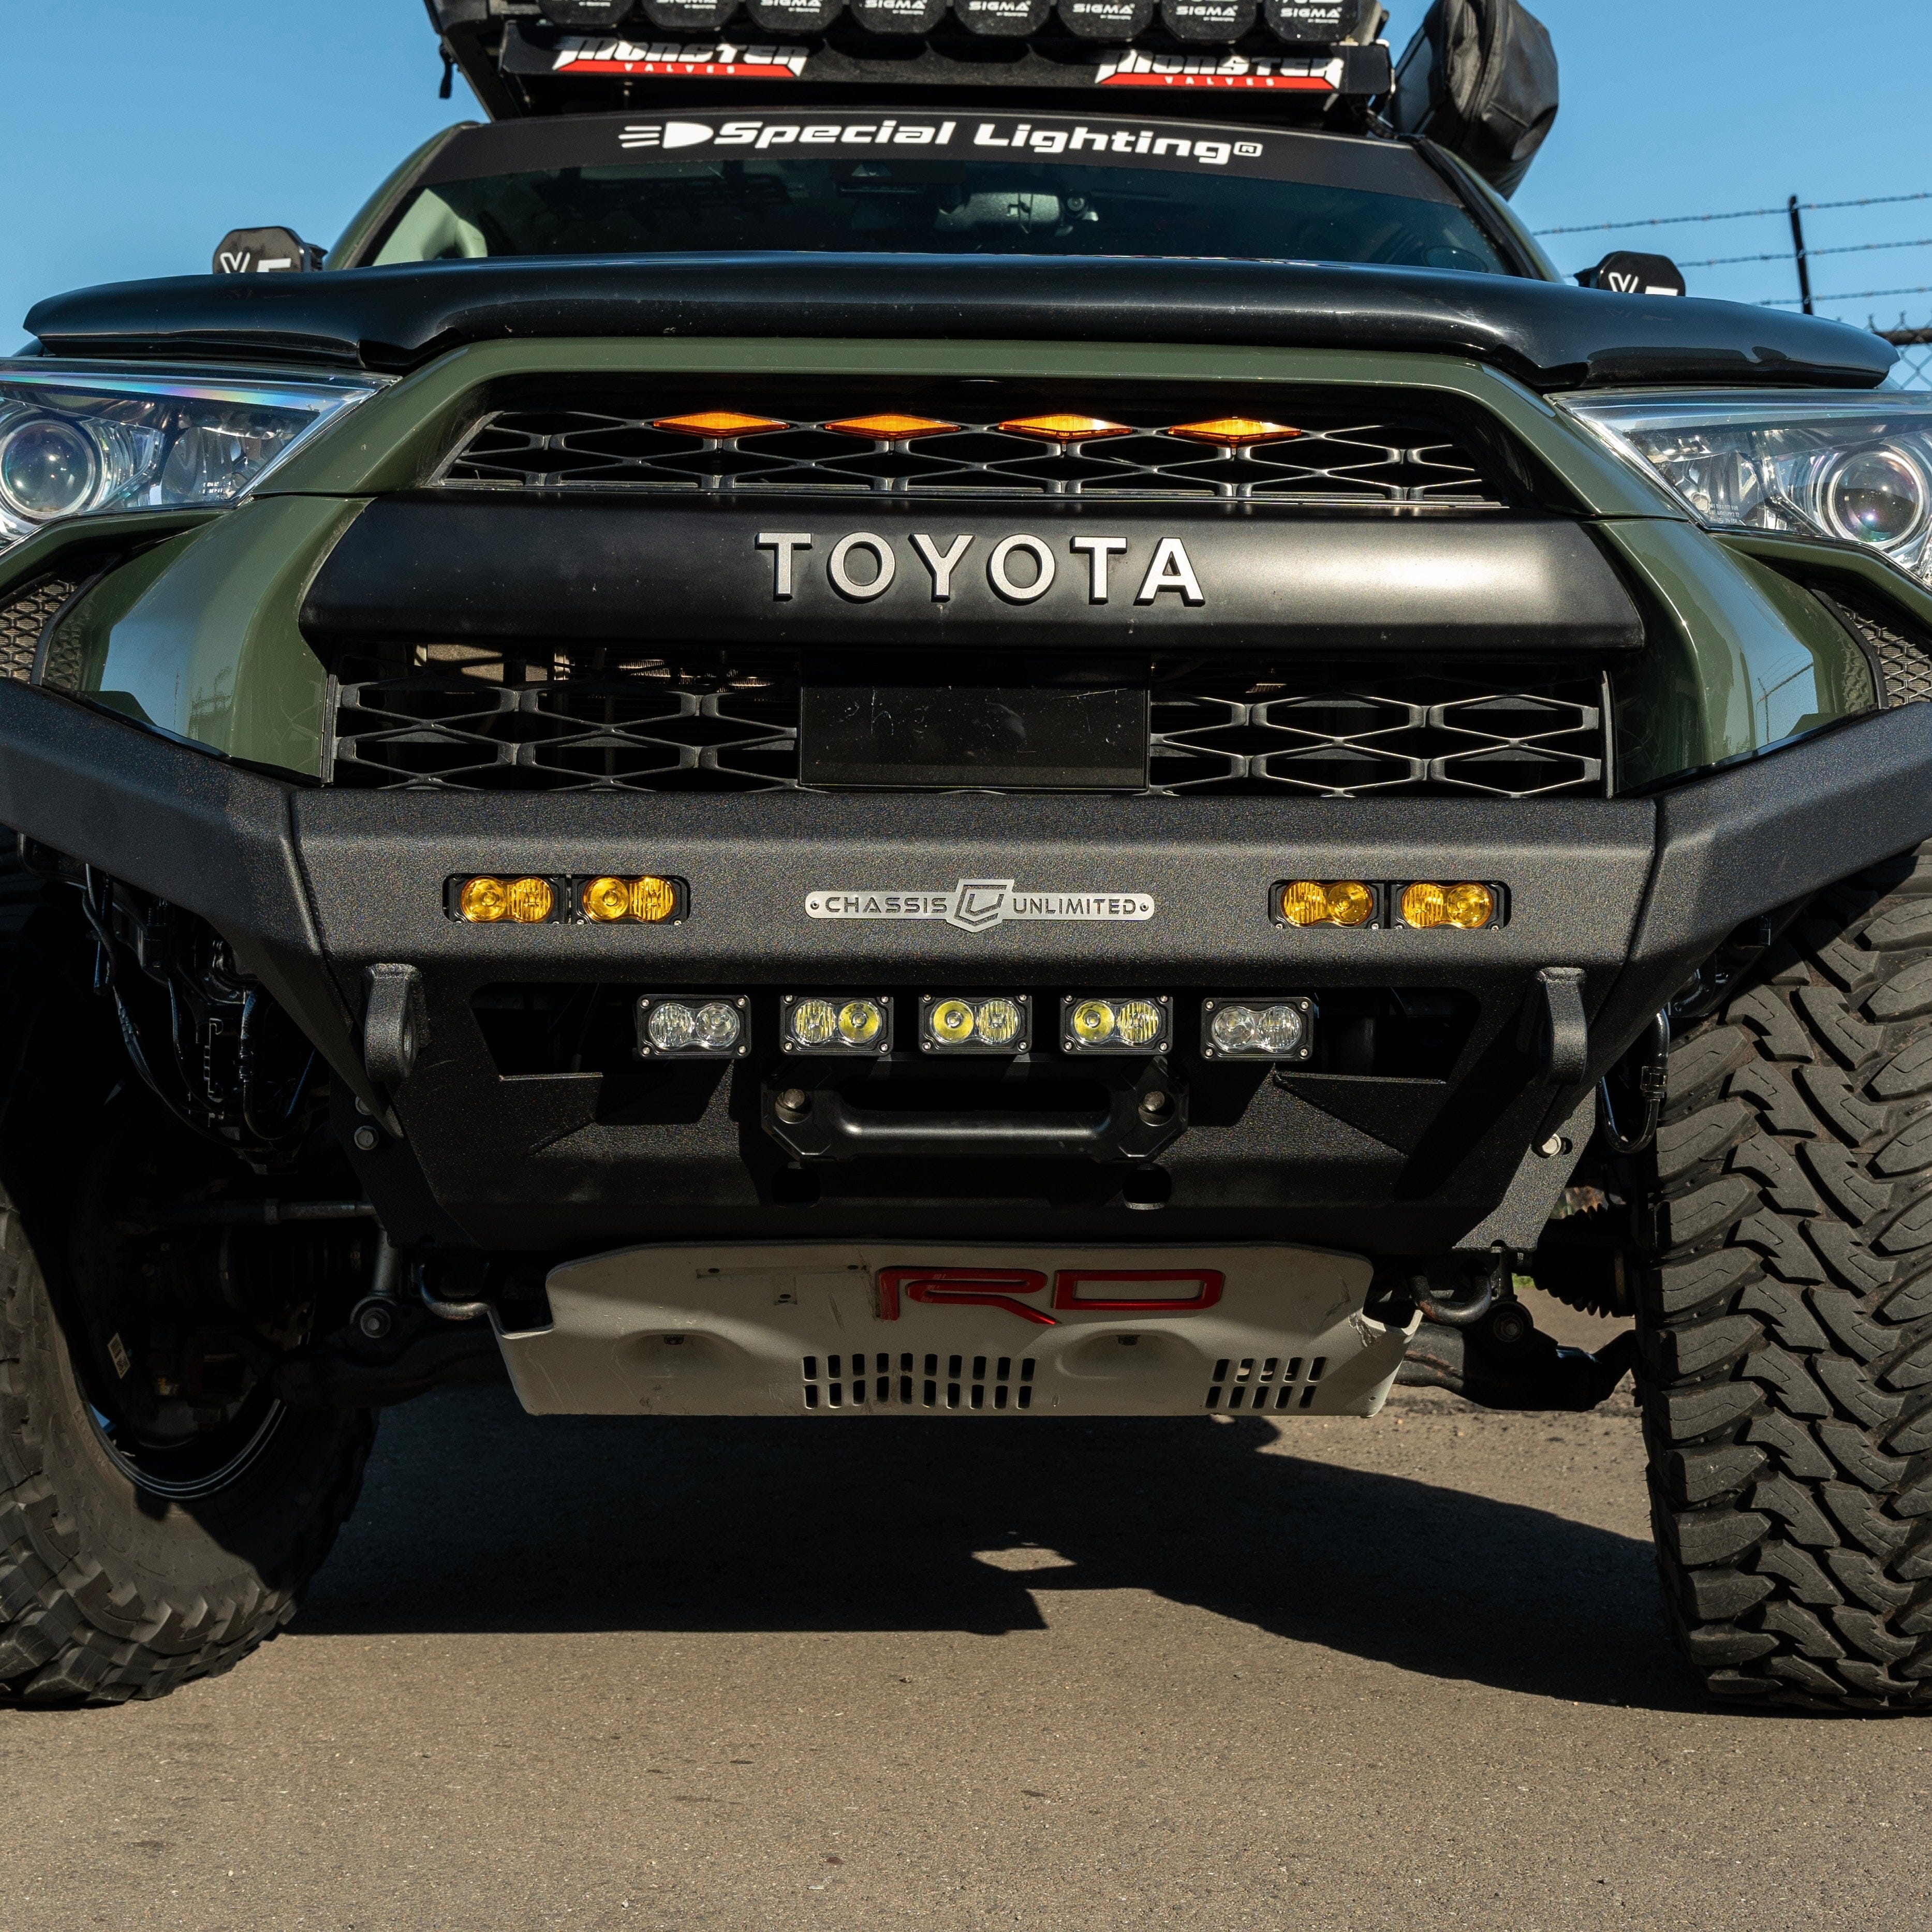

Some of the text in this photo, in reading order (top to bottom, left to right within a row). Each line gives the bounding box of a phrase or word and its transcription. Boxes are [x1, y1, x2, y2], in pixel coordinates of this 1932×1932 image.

[968, 1, 1029, 11] SIGMA
[1072, 3, 1133, 14] SIGMA
[1175, 6, 1237, 17] SIGMA
[1280, 7, 1341, 18] SIGMA
[624, 62, 735, 74] VALVES
[1164, 76, 1275, 87] VALVES
[714, 120, 955, 149] Special
[755, 531, 1205, 606] TOYOTA
[825, 896, 948, 913] CHASSIS
[1013, 898, 1136, 915] UNLIMITED
